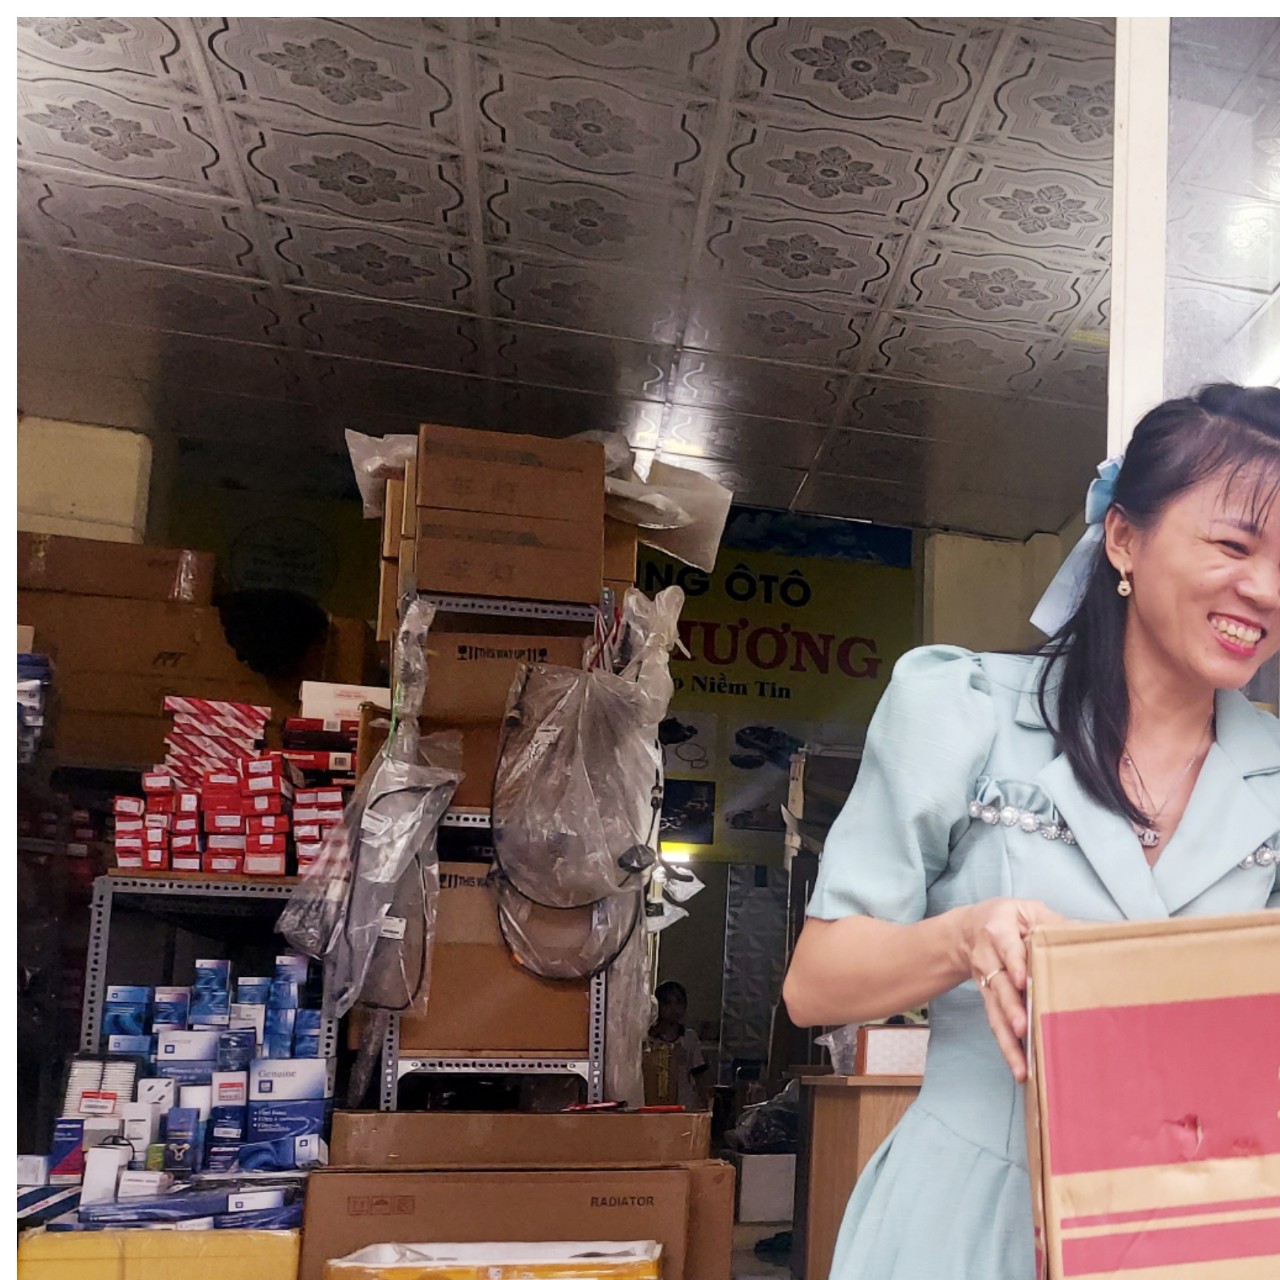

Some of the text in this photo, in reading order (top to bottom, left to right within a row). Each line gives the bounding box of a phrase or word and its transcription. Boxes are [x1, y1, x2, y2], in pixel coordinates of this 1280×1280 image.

[724, 562, 812, 607] ÔTÔ
[690, 672, 791, 700] Niềm Tin
[590, 1195, 655, 1209] RADIATOR
